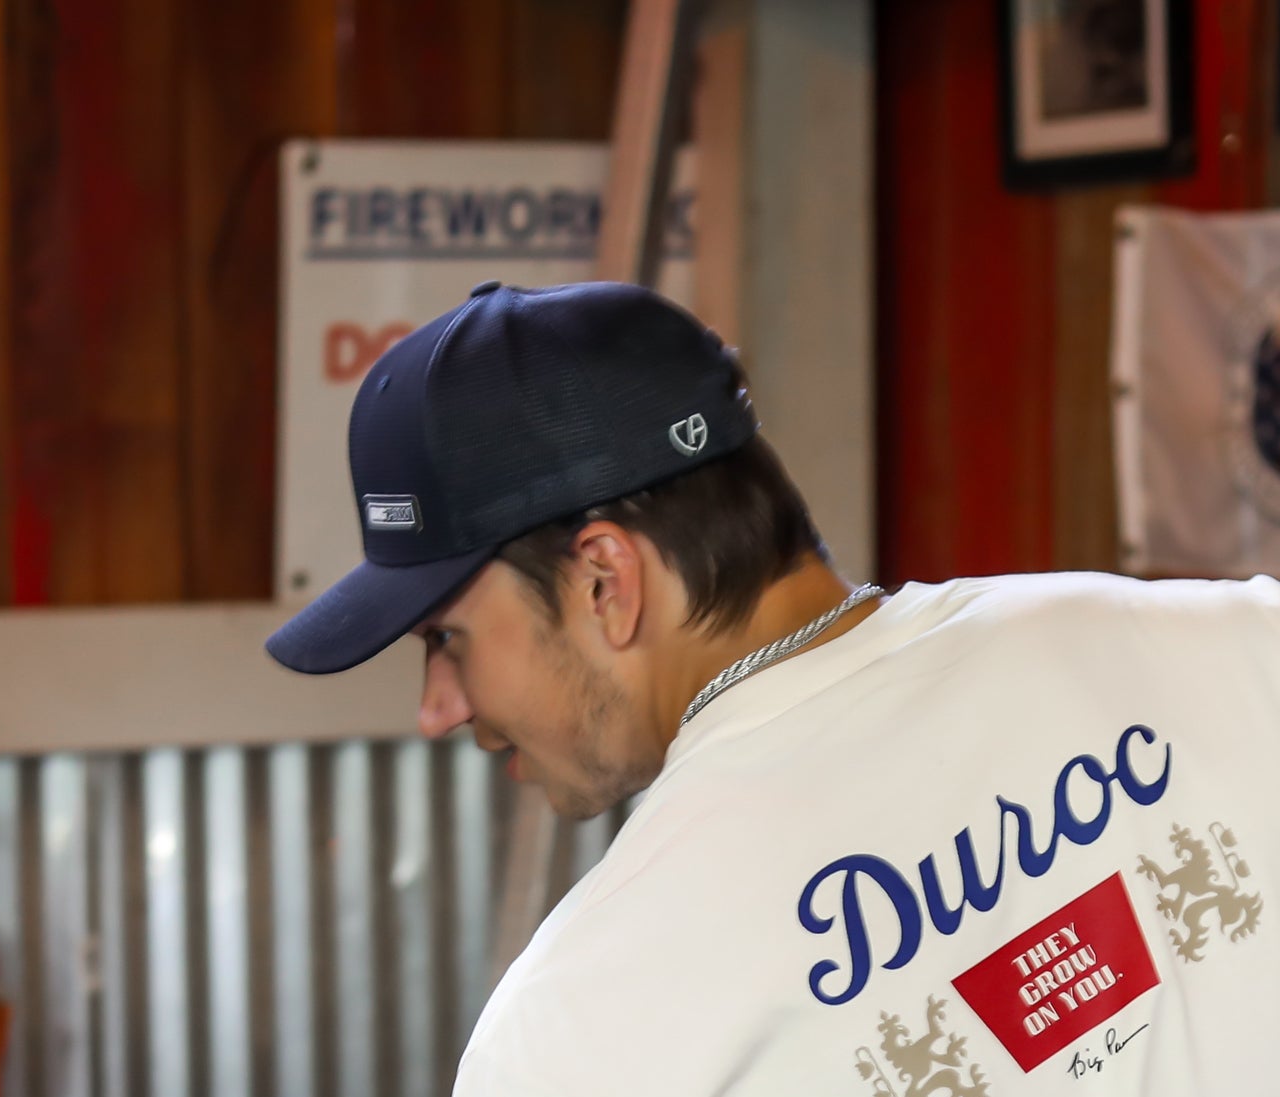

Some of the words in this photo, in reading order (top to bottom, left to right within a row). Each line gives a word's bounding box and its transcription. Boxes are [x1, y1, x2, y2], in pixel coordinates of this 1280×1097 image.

[797, 723, 1172, 1006] Duroc
[1010, 921, 1081, 978] THEY
[1018, 943, 1097, 1007] GROW
[1022, 1001, 1061, 1037] ON
[1058, 963, 1124, 1012] YOU.
